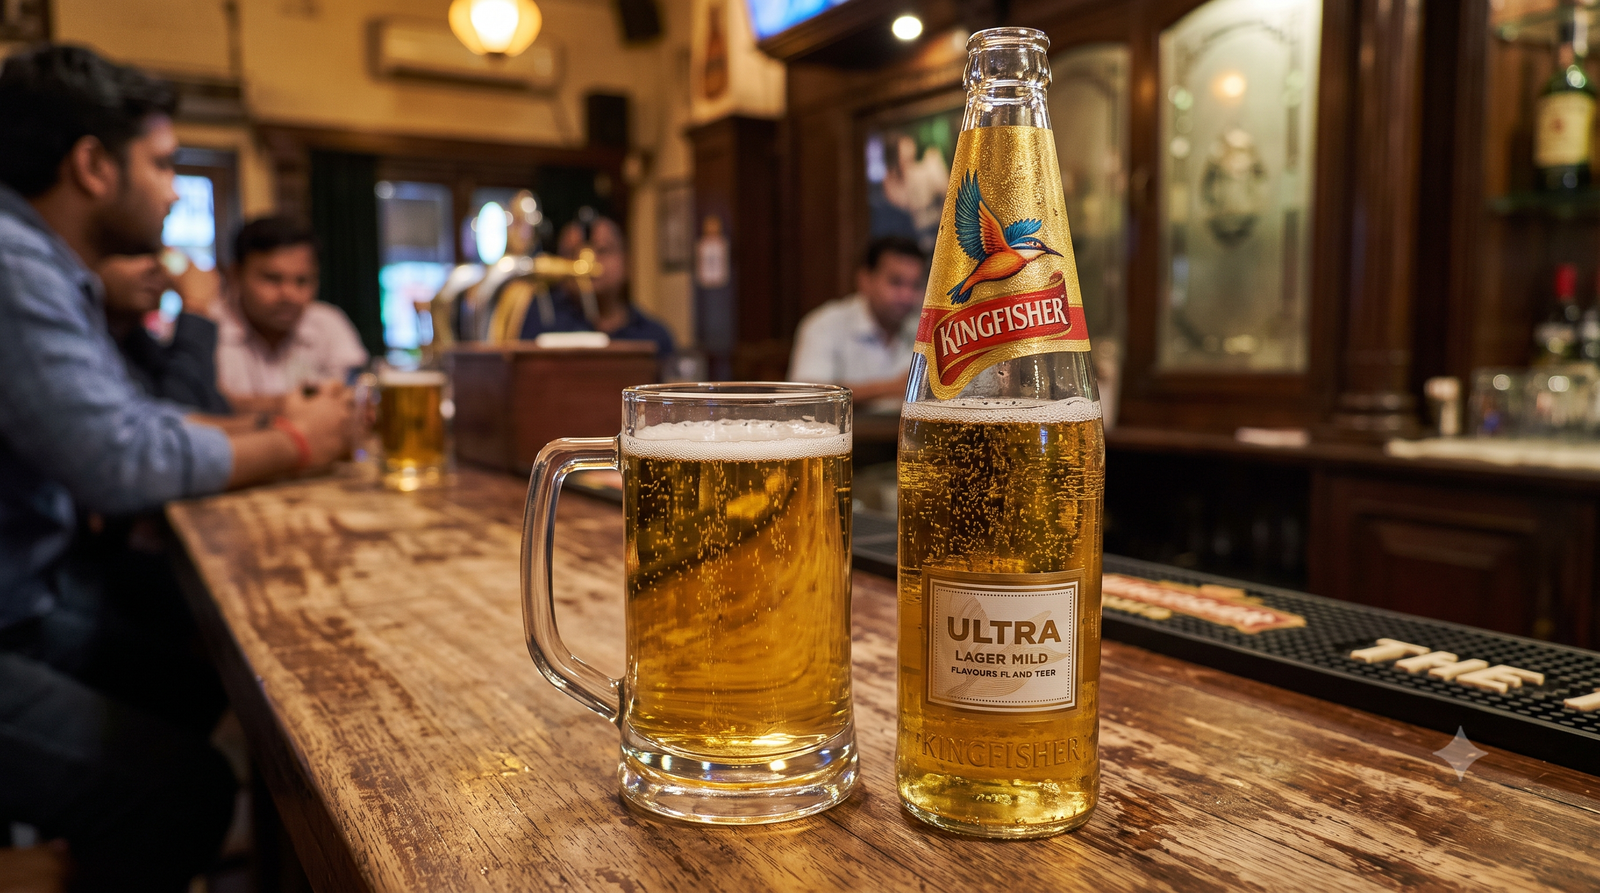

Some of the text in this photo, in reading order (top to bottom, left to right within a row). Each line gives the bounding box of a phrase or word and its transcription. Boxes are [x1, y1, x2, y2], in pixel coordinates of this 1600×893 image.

[940, 297, 1069, 357] KINGFISHER
[947, 616, 1062, 645] ULTRA
[951, 666, 998, 678] FLAVOURS
[1035, 669, 1056, 678] TEER
[955, 650, 1049, 665] LAGER MILD
[1350, 638, 1545, 694] THE
[921, 733, 1081, 769] KINGFISHER
